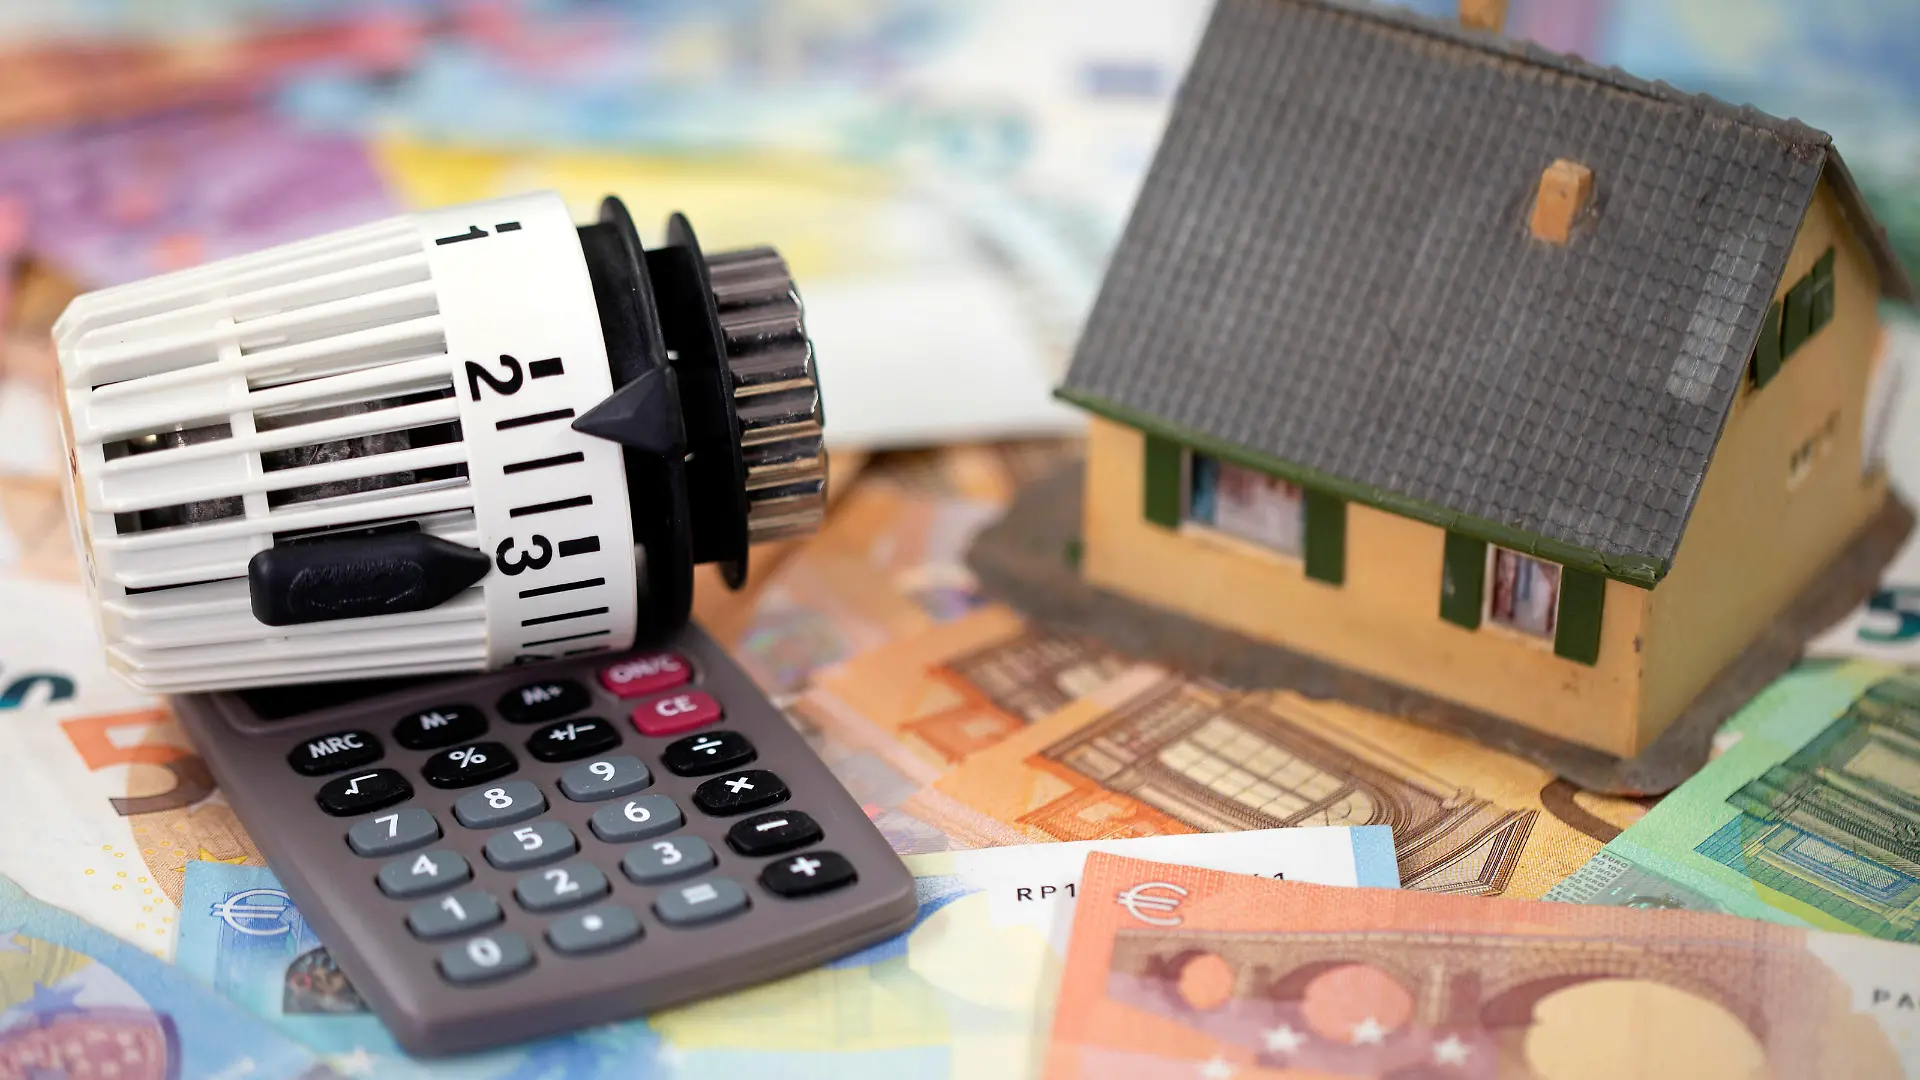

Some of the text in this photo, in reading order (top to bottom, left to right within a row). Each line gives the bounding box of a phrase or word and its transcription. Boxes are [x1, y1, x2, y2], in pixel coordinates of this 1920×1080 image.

[435, 224, 489, 246] 1
[465, 354, 523, 402] 2
[495, 534, 553, 577] 3
[608, 656, 682, 684] ON/C
[655, 695, 698, 717] CE
[308, 733, 364, 759] MRC
[448, 747, 487, 769] %
[589, 761, 615, 782] 9
[483, 787, 513, 809] 8
[624, 801, 650, 822] 6
[375, 813, 399, 838] 7
[513, 827, 543, 850] 5
[652, 841, 682, 865] 3
[411, 854, 438, 877] 4
[544, 868, 579, 895] 2
[440, 896, 467, 921] 1
[466, 936, 502, 967] 0
